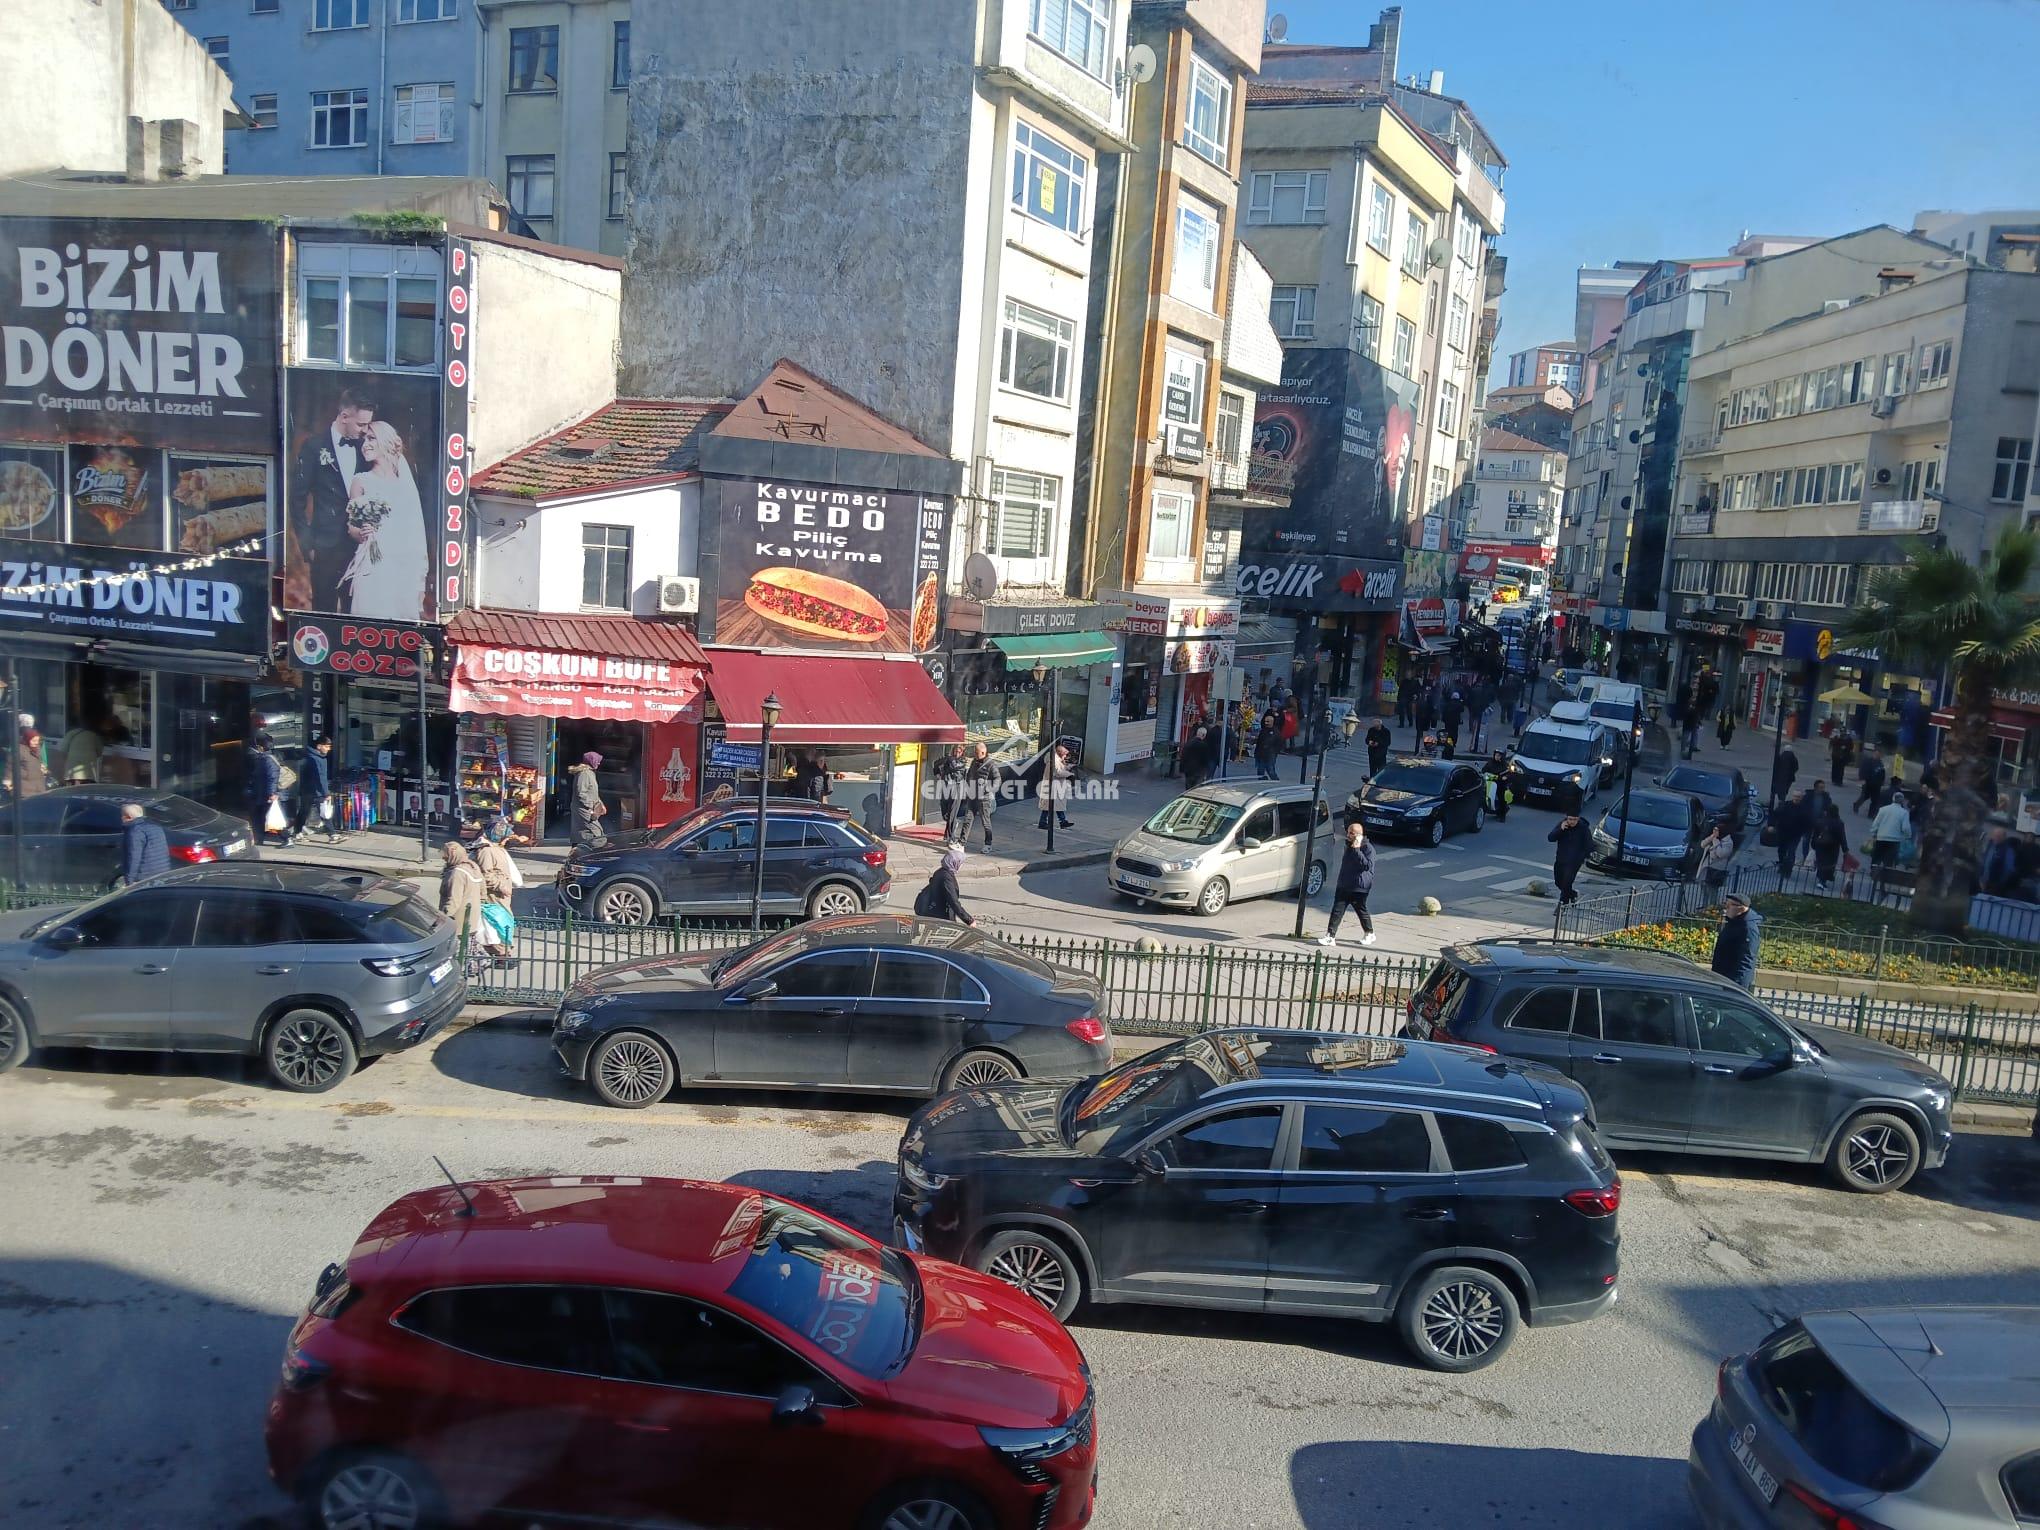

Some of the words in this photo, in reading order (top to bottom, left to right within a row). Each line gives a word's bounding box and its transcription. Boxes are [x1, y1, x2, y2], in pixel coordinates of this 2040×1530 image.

[448, 247, 467, 388] FOTO
[1, 311, 247, 398] DÖNER
[37, 393, 100, 411] Çarşının
[105, 397, 150, 413] Ortak
[154, 400, 212, 417] Lezzeti
[757, 482, 886, 508] Kavurmacı
[446, 433, 464, 602] GÖZDE
[757, 501, 885, 531] BEDO
[793, 530, 848, 548] Piliç
[755, 542, 882, 564] Kavurma
[93, 562, 245, 624] DÖNER
[1135, 600, 1166, 615] beyaz
[89, 615, 117, 628] Ortak
[341, 625, 423, 652] FOTO
[329, 650, 419, 677] GÖZD
[484, 649, 599, 679] COŞKUN
